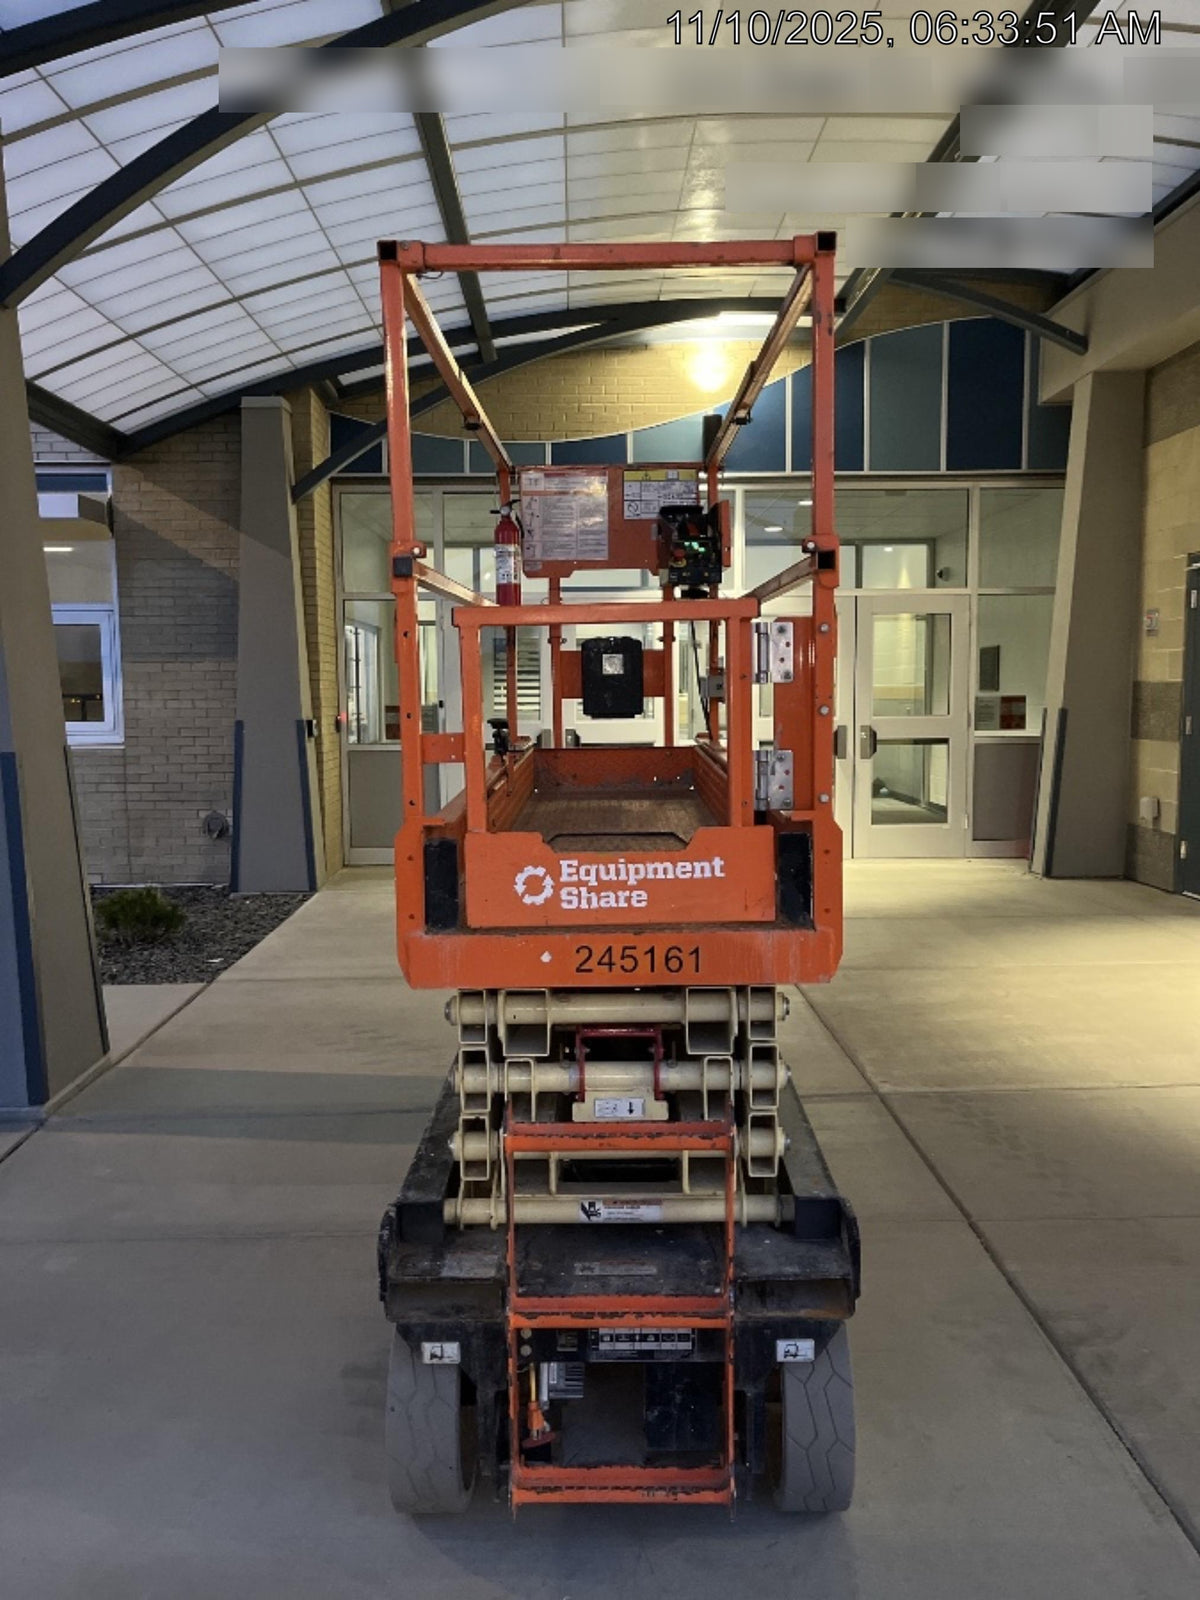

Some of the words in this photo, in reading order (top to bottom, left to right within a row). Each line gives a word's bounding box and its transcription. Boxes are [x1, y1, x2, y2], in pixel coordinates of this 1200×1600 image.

[559, 856, 726, 887] Equipment
[559, 886, 649, 910] Share
[575, 945, 701, 974] 245161
